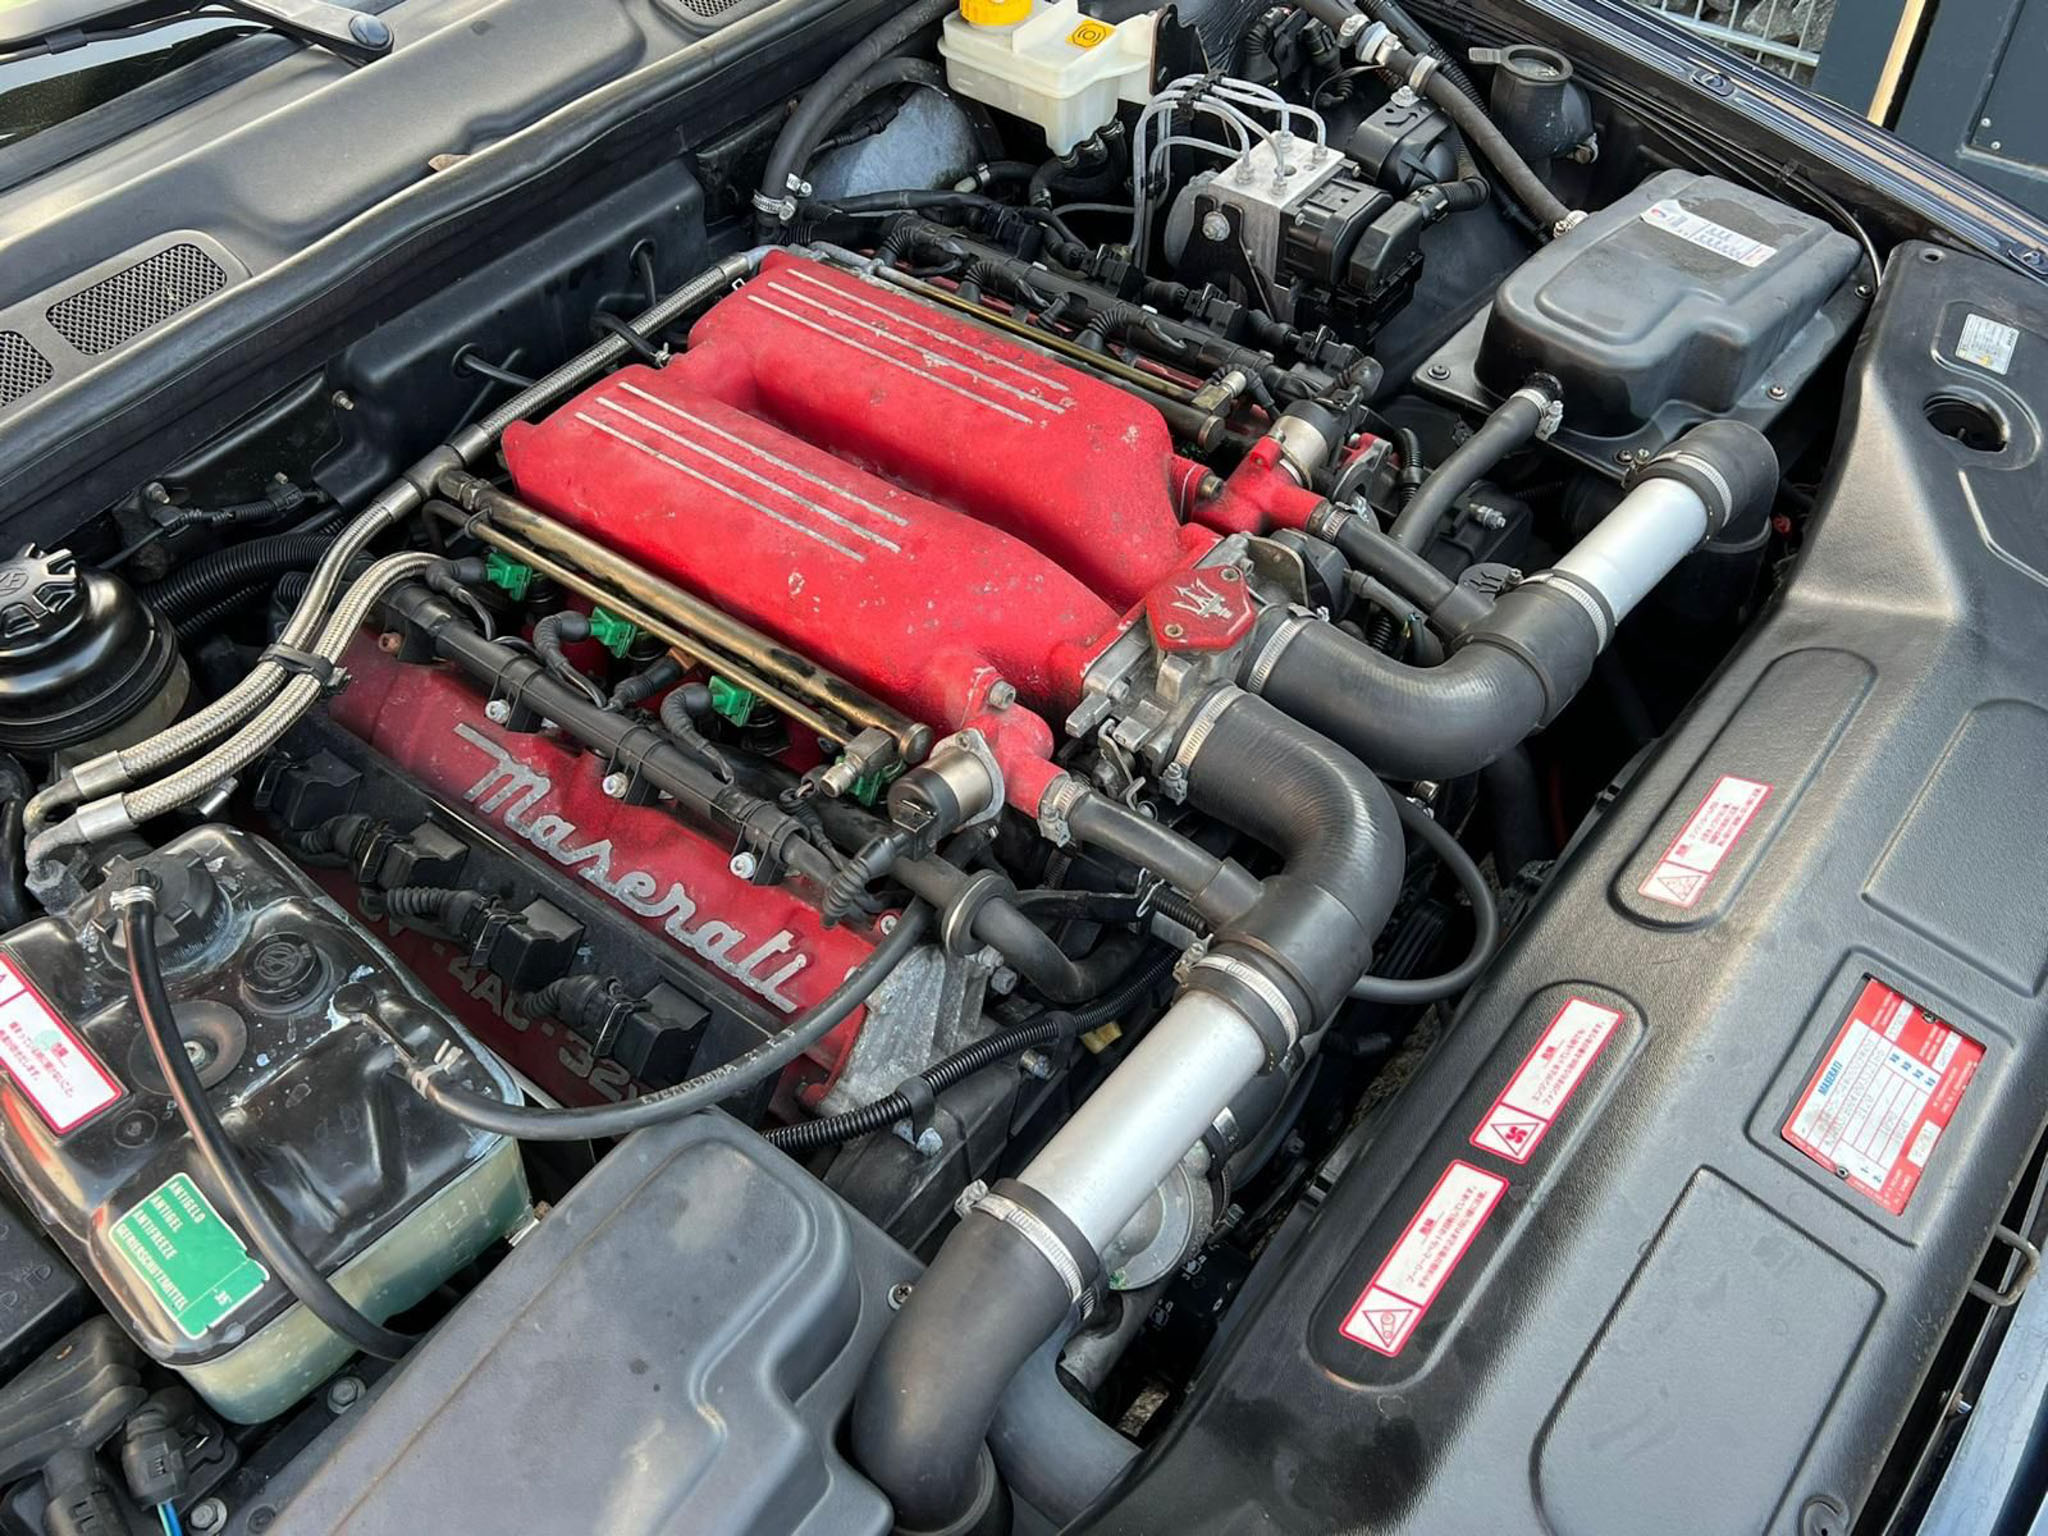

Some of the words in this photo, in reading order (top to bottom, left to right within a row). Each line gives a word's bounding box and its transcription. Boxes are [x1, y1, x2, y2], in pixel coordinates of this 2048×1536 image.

[453, 722, 807, 1014] Maserati
[151, 1195, 184, 1234] ANTIGEL
[169, 1180, 206, 1224] ANTIGELO
[132, 1208, 178, 1260] ANTIFREEZE
